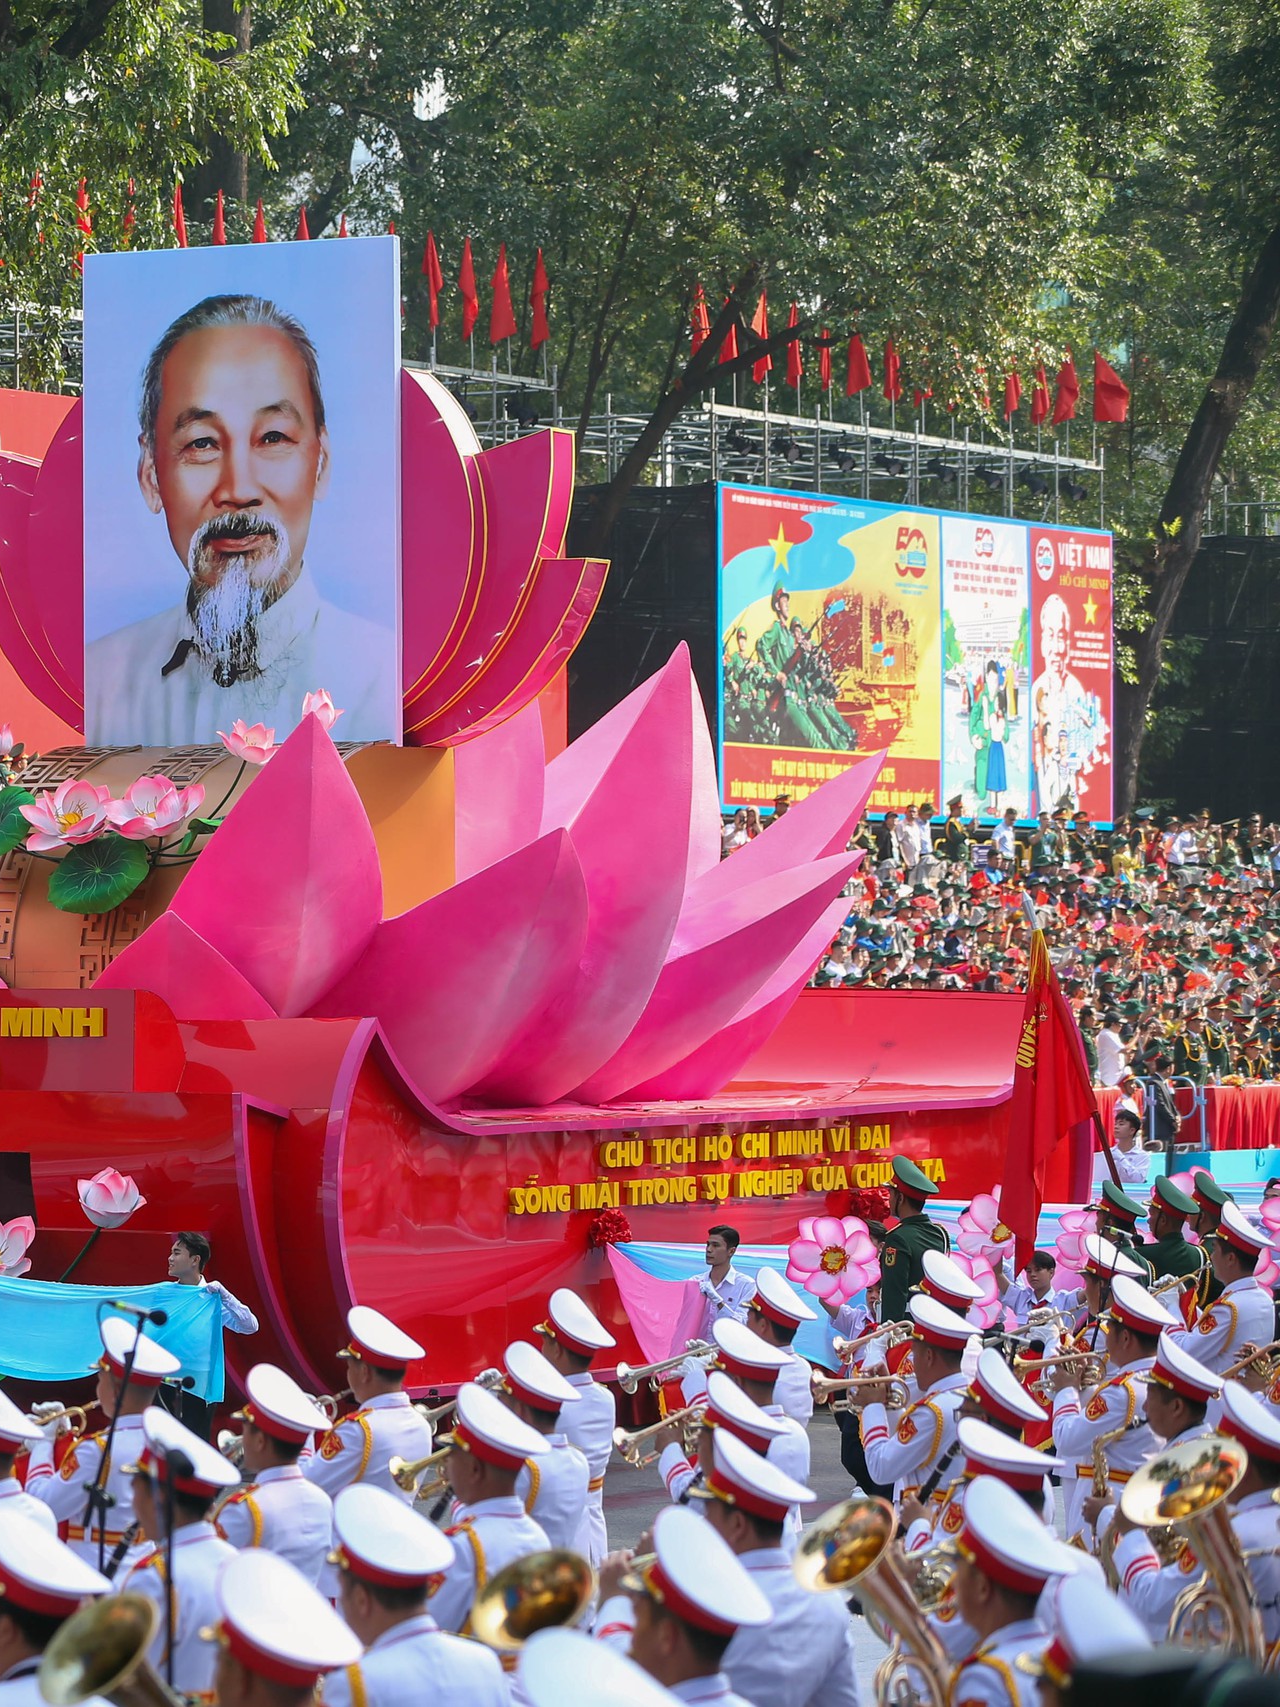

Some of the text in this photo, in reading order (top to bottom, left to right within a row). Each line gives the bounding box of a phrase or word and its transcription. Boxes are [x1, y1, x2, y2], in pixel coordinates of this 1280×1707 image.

[1058, 537, 1083, 572] VIỆT
[1086, 545, 1111, 571] NAM
[0, 1007, 104, 1037] MINH
[600, 1131, 644, 1169] CHỦ
[649, 1137, 697, 1171] TỊCH
[737, 1124, 770, 1159] CHÍ
[774, 1129, 824, 1156] MINH
[856, 1124, 891, 1156] ĐẠI
[509, 1174, 571, 1215] SỐNG
[574, 1176, 620, 1210] MÃI
[623, 1176, 697, 1207] TRONG
[701, 1173, 731, 1205] SỰ
[734, 1163, 804, 1200] NGHIỆP
[806, 1157, 849, 1192] CỦA
[851, 1157, 896, 1189] CHÚ
